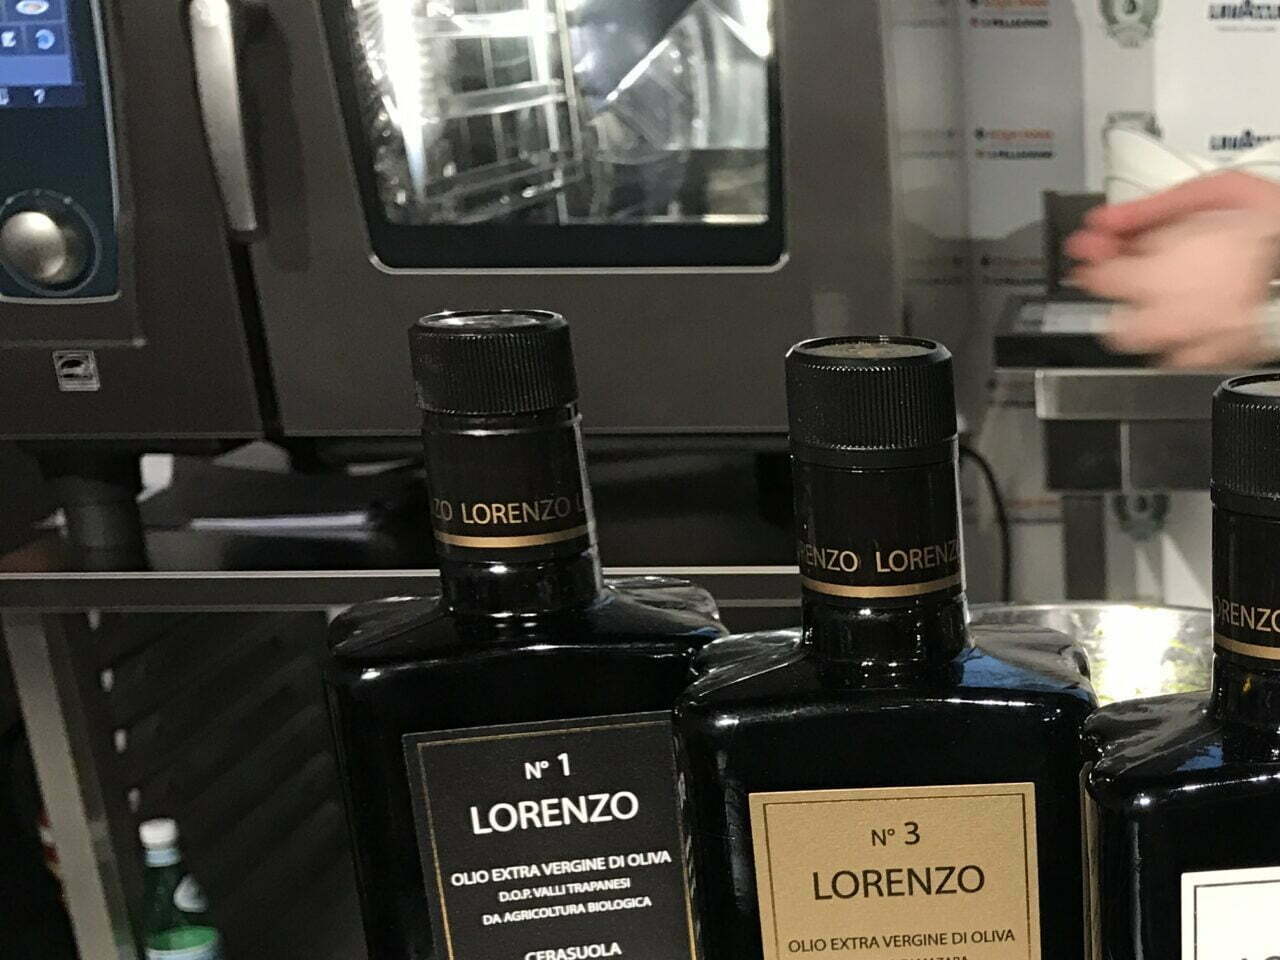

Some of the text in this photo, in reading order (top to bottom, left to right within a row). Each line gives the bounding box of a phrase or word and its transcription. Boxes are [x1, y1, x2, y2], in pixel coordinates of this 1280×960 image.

[461, 496, 570, 525] LORENZO
[557, 752, 571, 777] 1
[470, 790, 639, 835] LORENZO
[904, 821, 921, 846] 3
[451, 850, 672, 887] OLIO EXTRA VERGINE DI OLIVA
[812, 864, 985, 901] LORENZO
[533, 884, 566, 899] VALLI
[567, 877, 631, 896] TRAPANESI
[482, 896, 652, 926] DA AGRICOLTURA BIOLOGICA
[788, 929, 1015, 953] OLIO EXTRA VERGINE DI OLIVA
